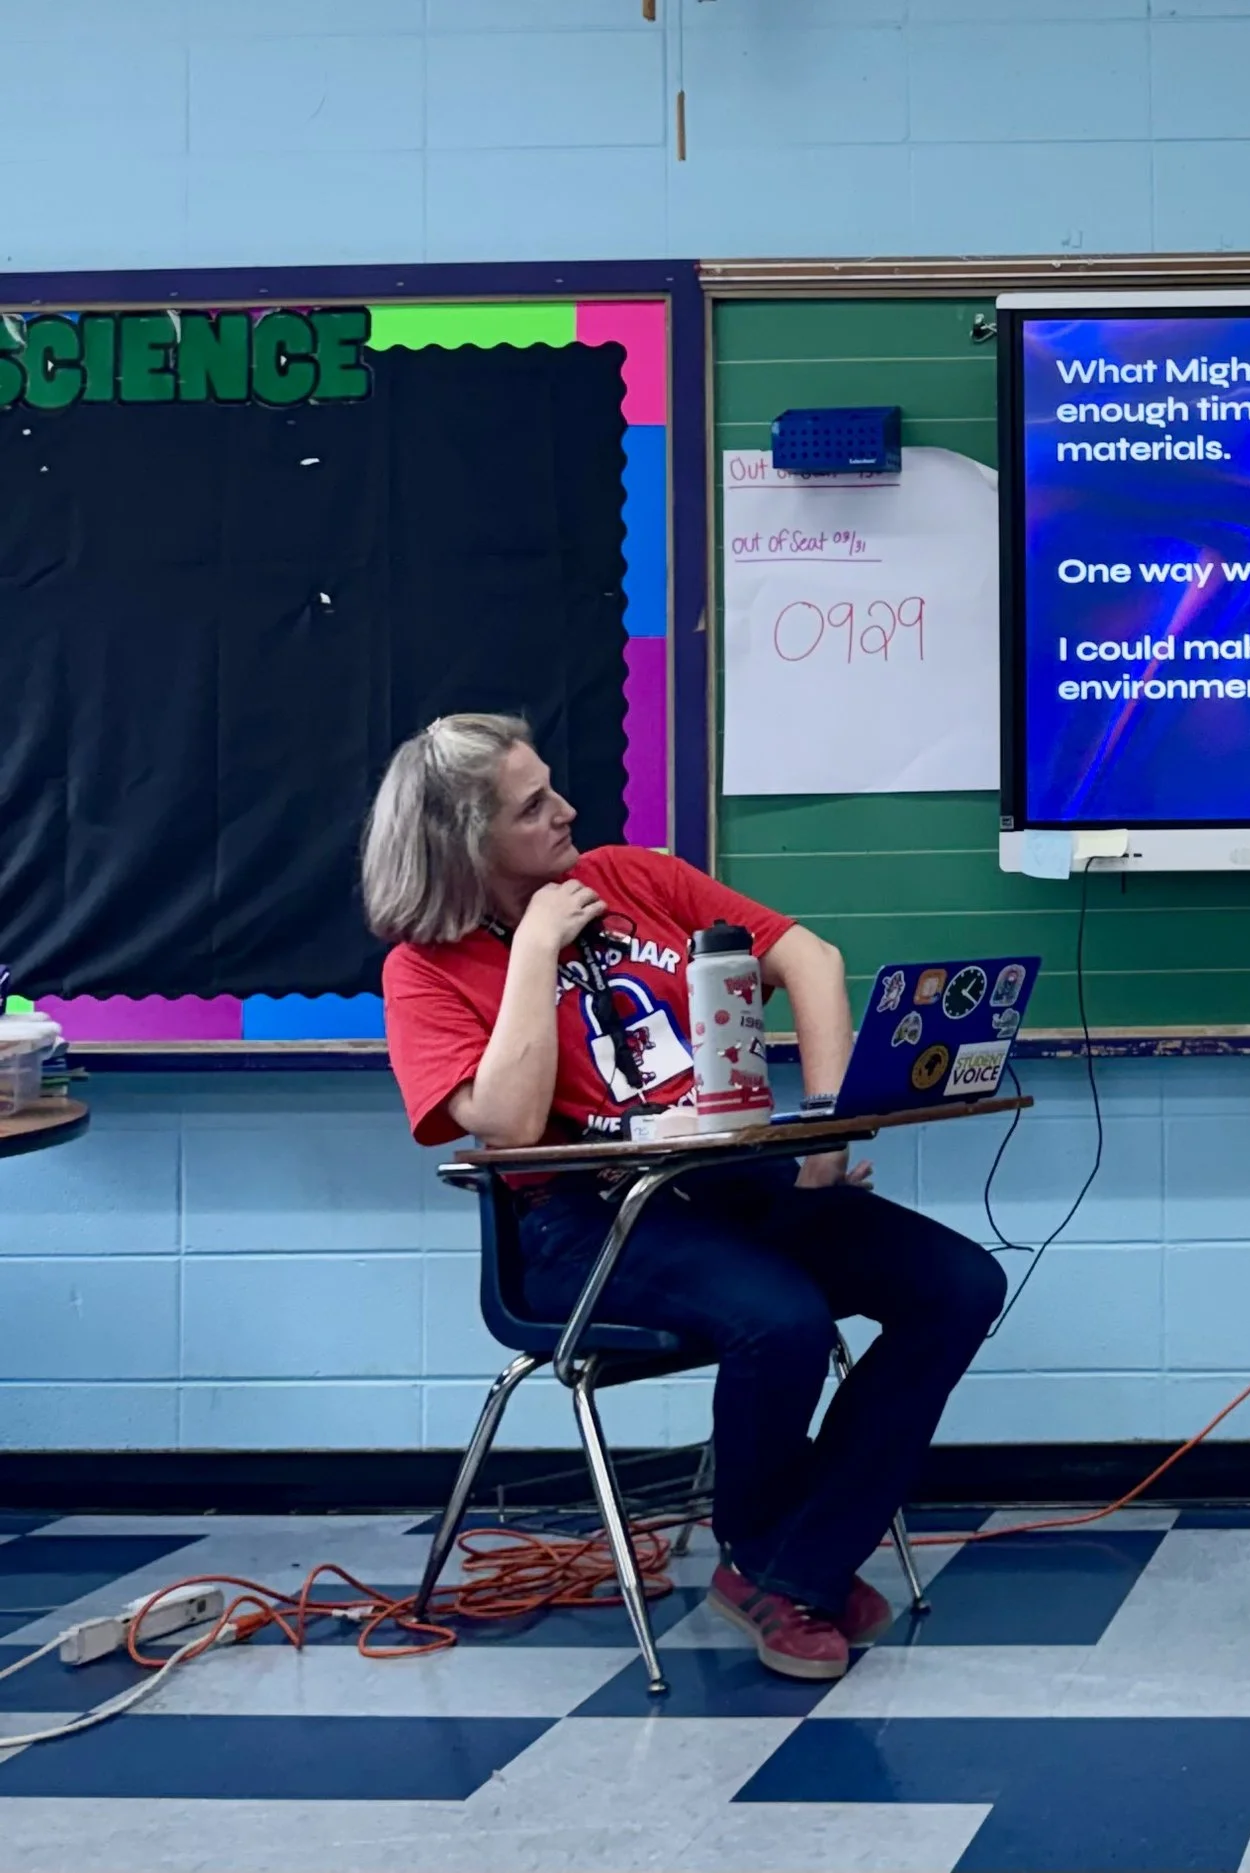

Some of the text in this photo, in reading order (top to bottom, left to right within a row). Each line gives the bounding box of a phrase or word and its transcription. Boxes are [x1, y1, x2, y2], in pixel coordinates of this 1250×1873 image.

[1055, 358, 1158, 384] What
[1056, 395, 1189, 429] enough
[1057, 434, 1231, 462] materials.
[730, 458, 768, 481] Out
[768, 528, 789, 553] of
[789, 529, 828, 553] Seat
[1058, 558, 1132, 584] One
[1138, 562, 1214, 589] way
[774, 596, 926, 664] 0929
[1059, 637, 1067, 661] I
[1076, 634, 1175, 662] could
[953, 1065, 1001, 1085] VOICE
